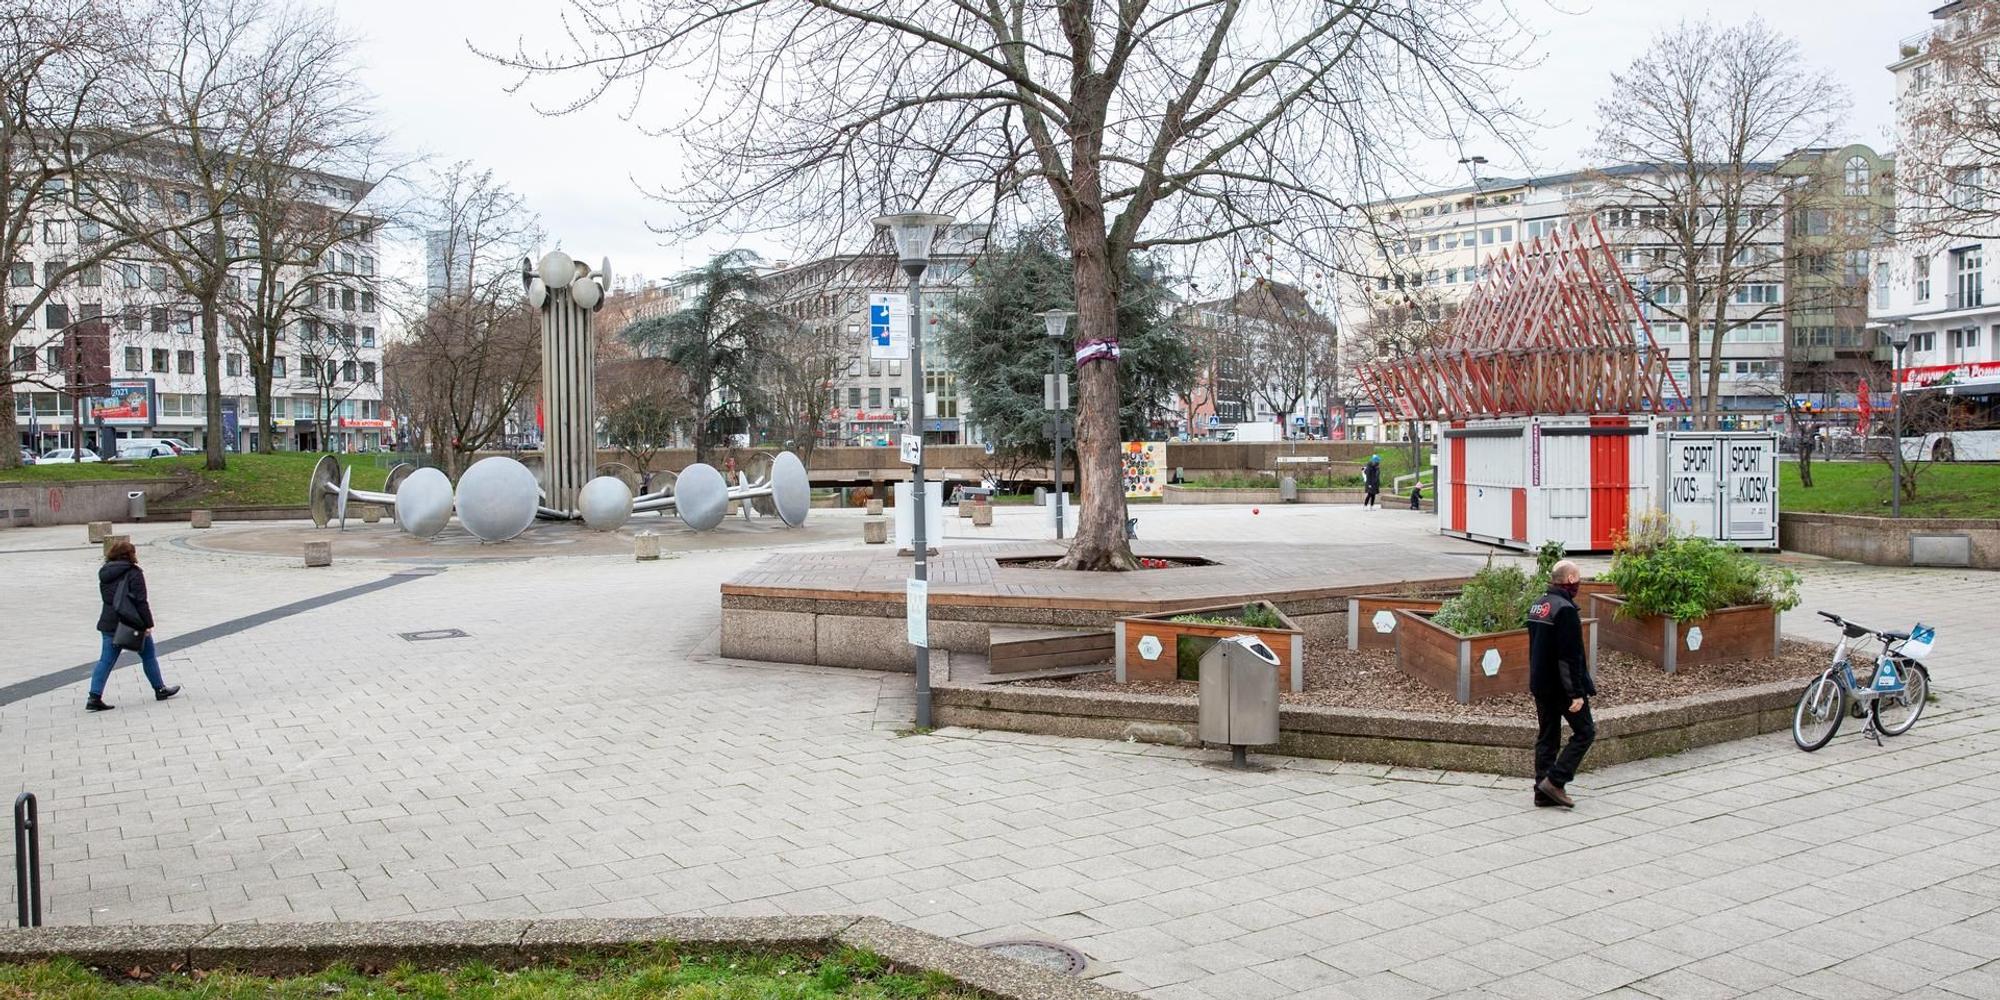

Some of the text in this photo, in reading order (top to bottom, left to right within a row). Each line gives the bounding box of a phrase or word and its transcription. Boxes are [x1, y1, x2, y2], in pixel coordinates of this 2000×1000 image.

[112, 389, 128, 397] 2021
[1683, 446, 1712, 471] SPORT
[1732, 446, 1761, 471] SPORT
[1673, 477, 1699, 502] KIOS
[1740, 477, 1768, 502] KIOSK
